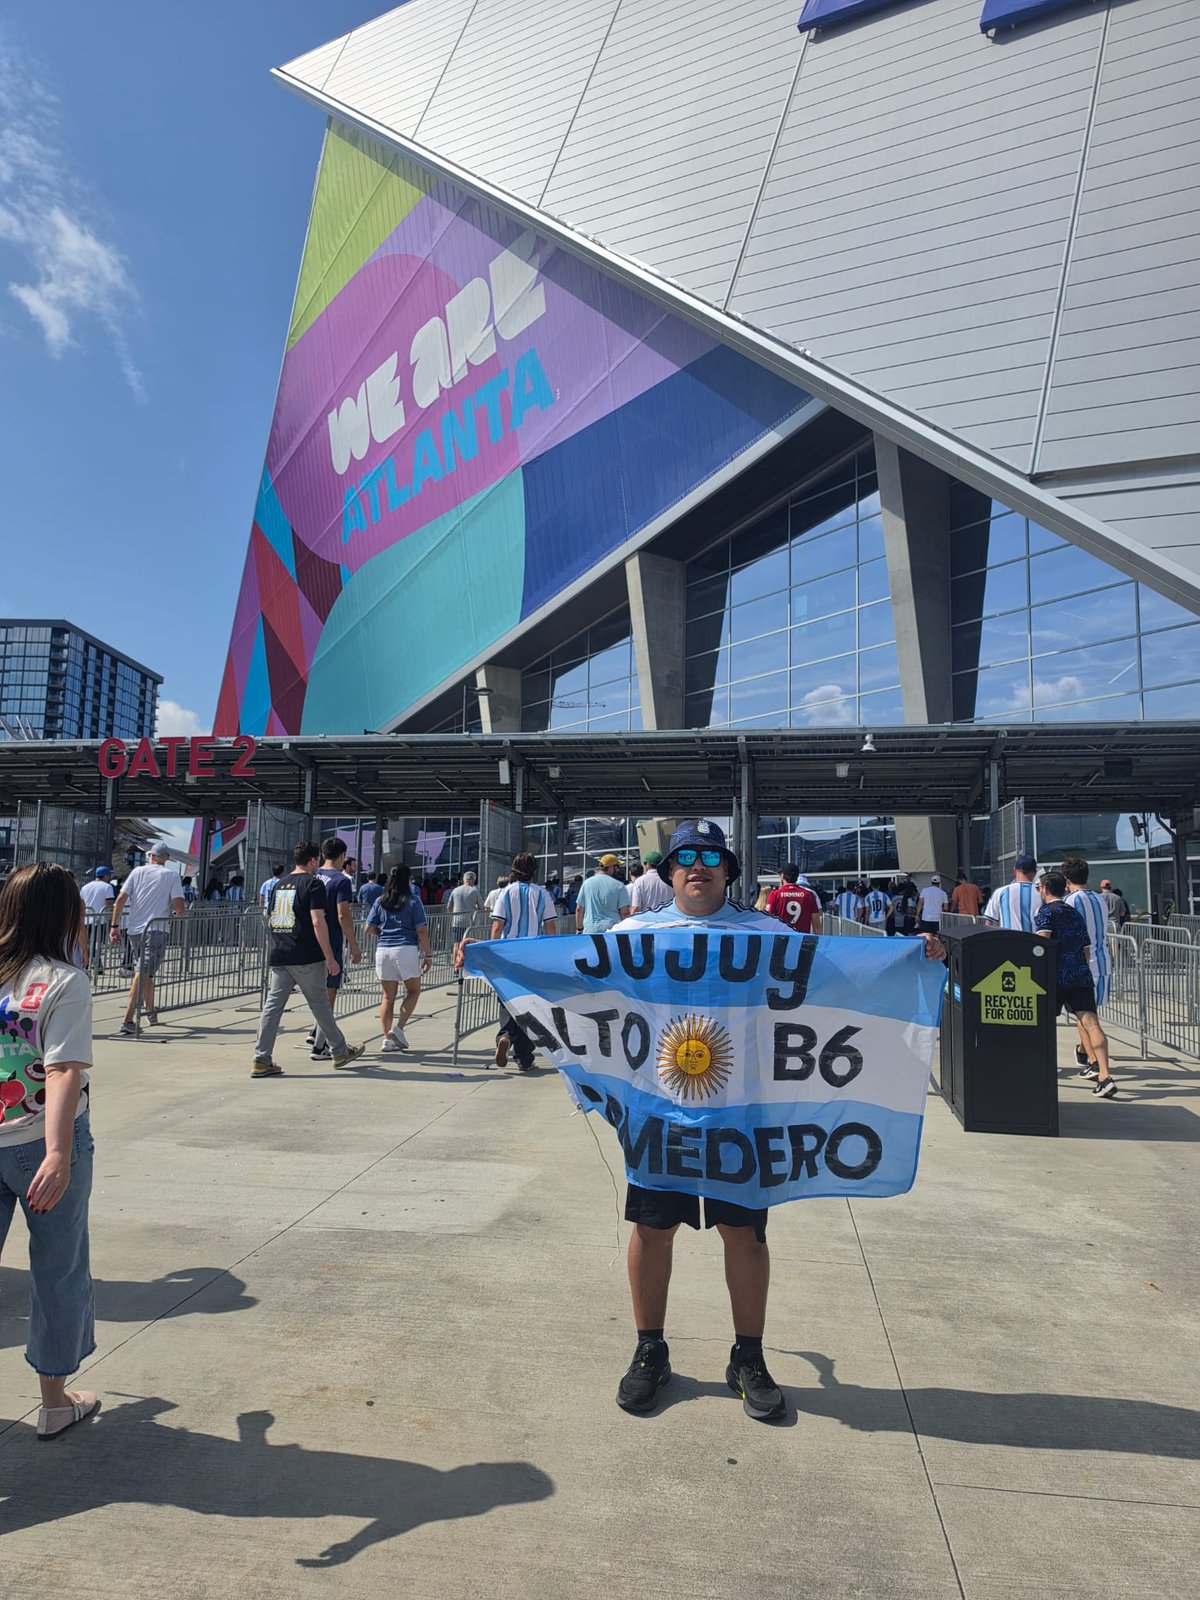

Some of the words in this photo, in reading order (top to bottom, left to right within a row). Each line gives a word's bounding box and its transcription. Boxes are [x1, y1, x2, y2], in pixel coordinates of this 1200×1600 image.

[327, 351, 406, 475] WE
[341, 347, 556, 545] ATLANTA
[98, 736, 217, 778] GATE
[231, 735, 257, 777] 2
[786, 901, 802, 924] 9
[984, 994, 1034, 1009] RECYCLE
[985, 1008, 1005, 1020] FOR
[1006, 1009, 1034, 1021] GOOD
[515, 1006, 651, 1071] ALTO
[772, 1022, 863, 1088] B6
